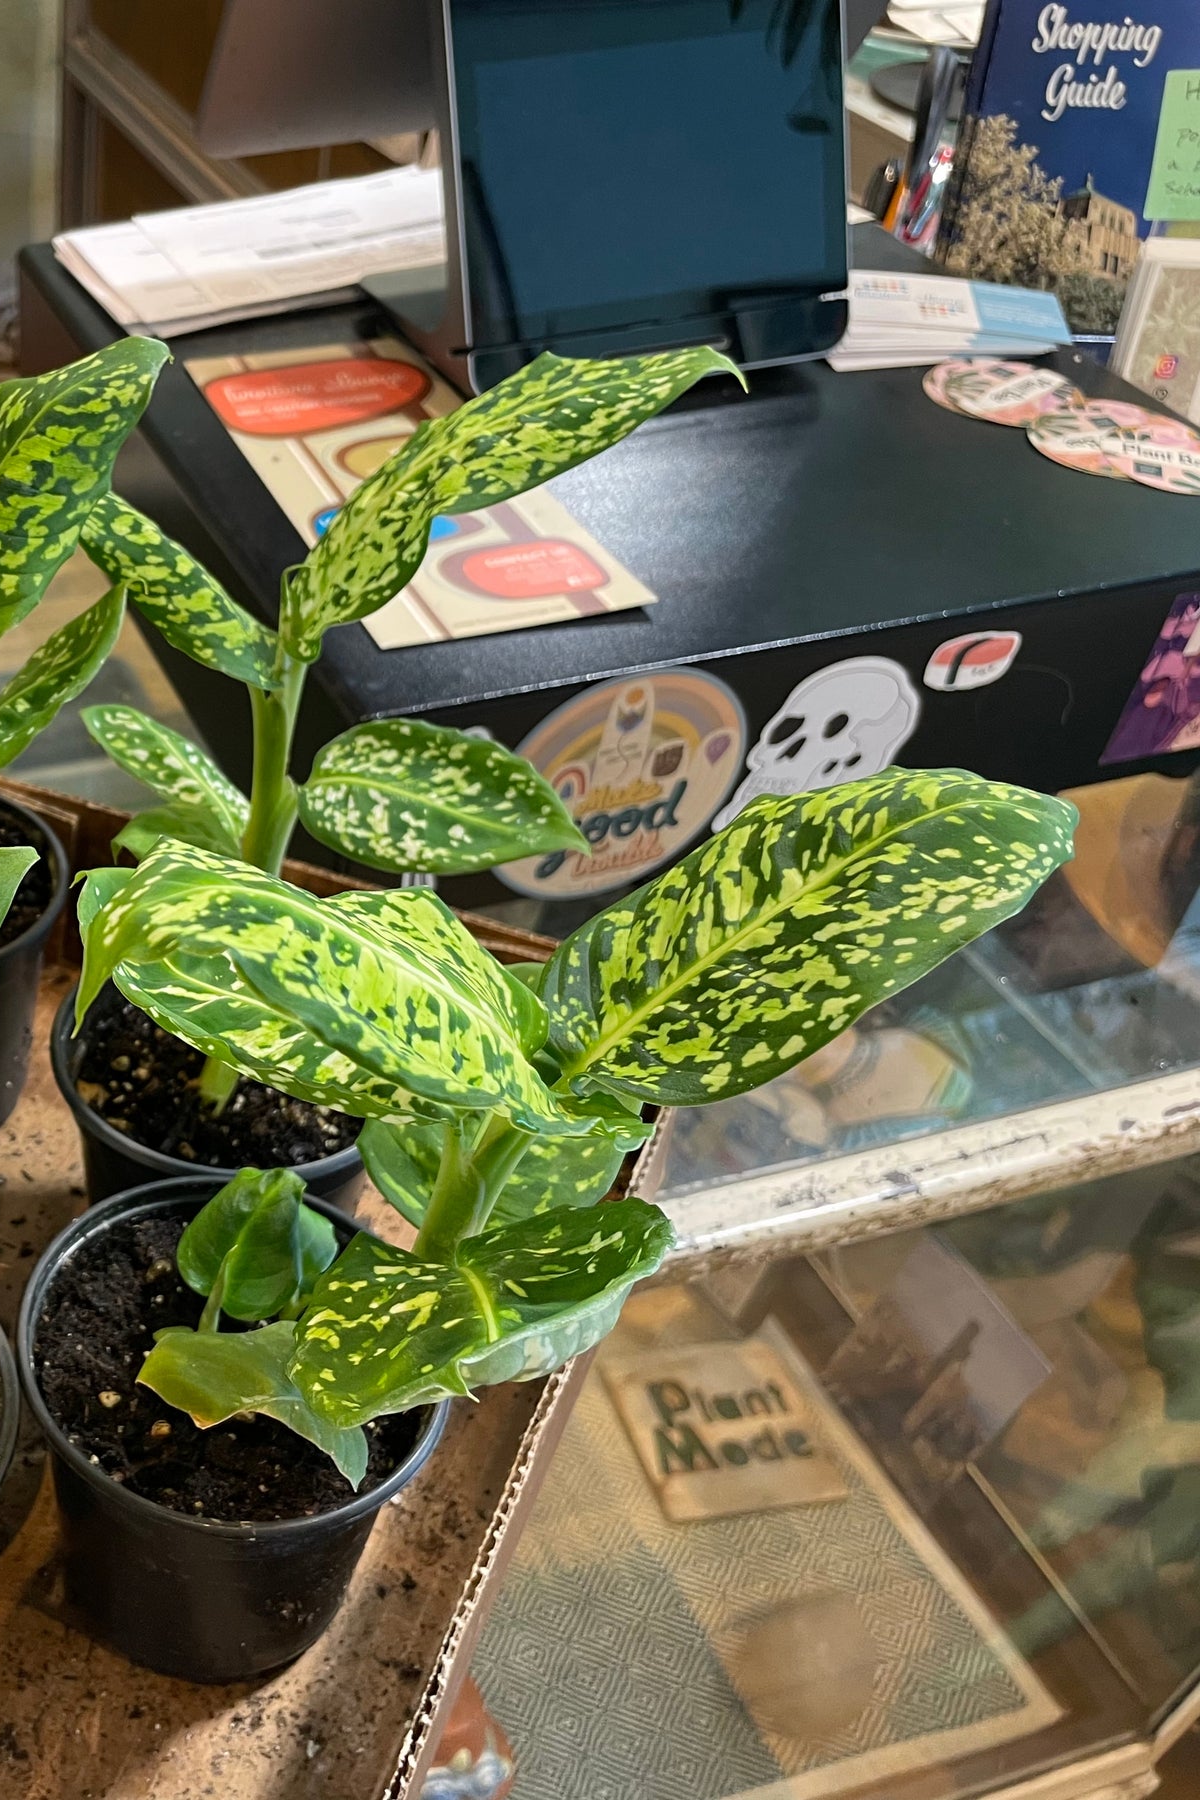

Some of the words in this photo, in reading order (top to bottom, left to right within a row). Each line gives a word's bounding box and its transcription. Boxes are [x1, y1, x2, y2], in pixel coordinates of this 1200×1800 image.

[1031, 2, 1162, 68] Shopping
[1040, 63, 1127, 122] Guide
[1122, 441, 1174, 464] Plant
[533, 779, 689, 881] ood
[646, 1377, 789, 1428] Plant
